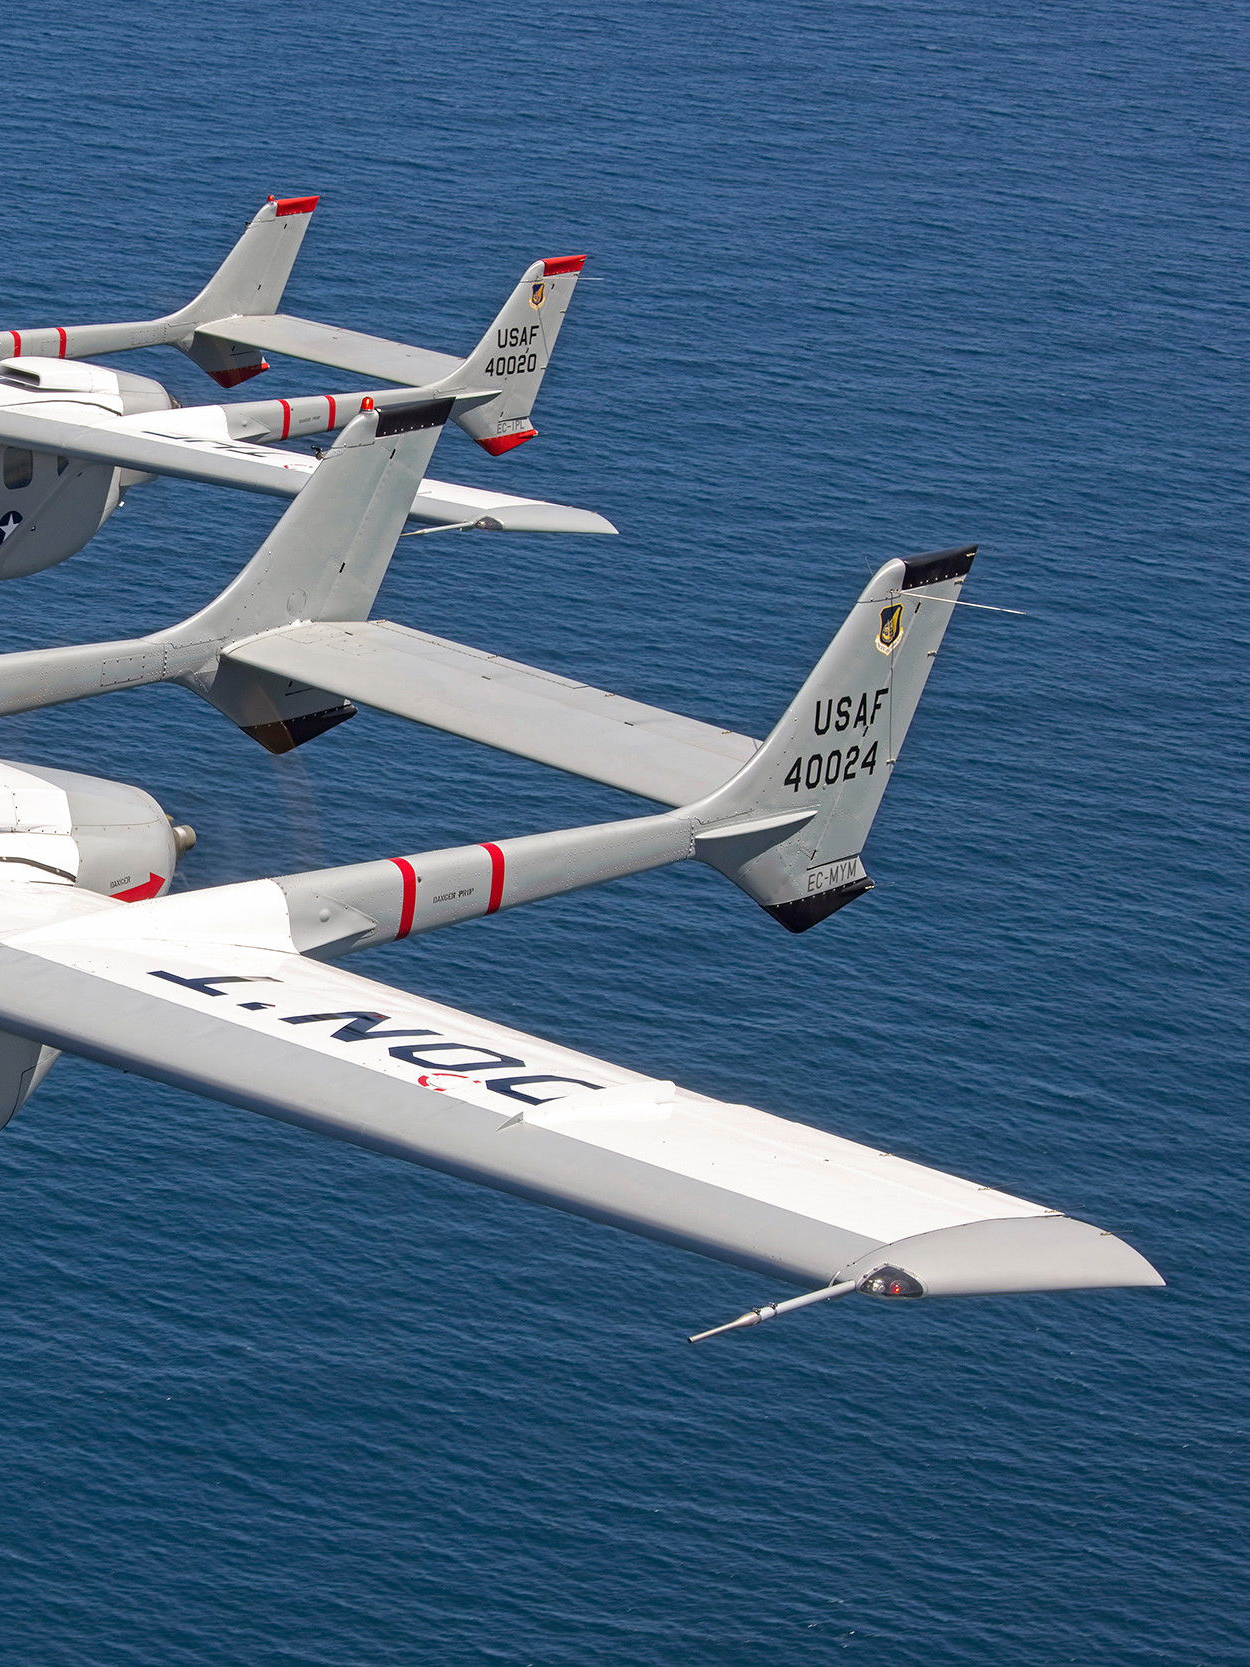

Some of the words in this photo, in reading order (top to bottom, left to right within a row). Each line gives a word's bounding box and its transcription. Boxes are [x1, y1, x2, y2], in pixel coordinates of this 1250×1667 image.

[497, 324, 540, 349] USAF
[485, 353, 537, 377] 40020
[496, 421, 525, 434] EC-IPL
[814, 687, 889, 736] USAF
[783, 740, 879, 793] 40024
[807, 859, 858, 893] EC-MYM
[146, 970, 607, 1106] DON'T
